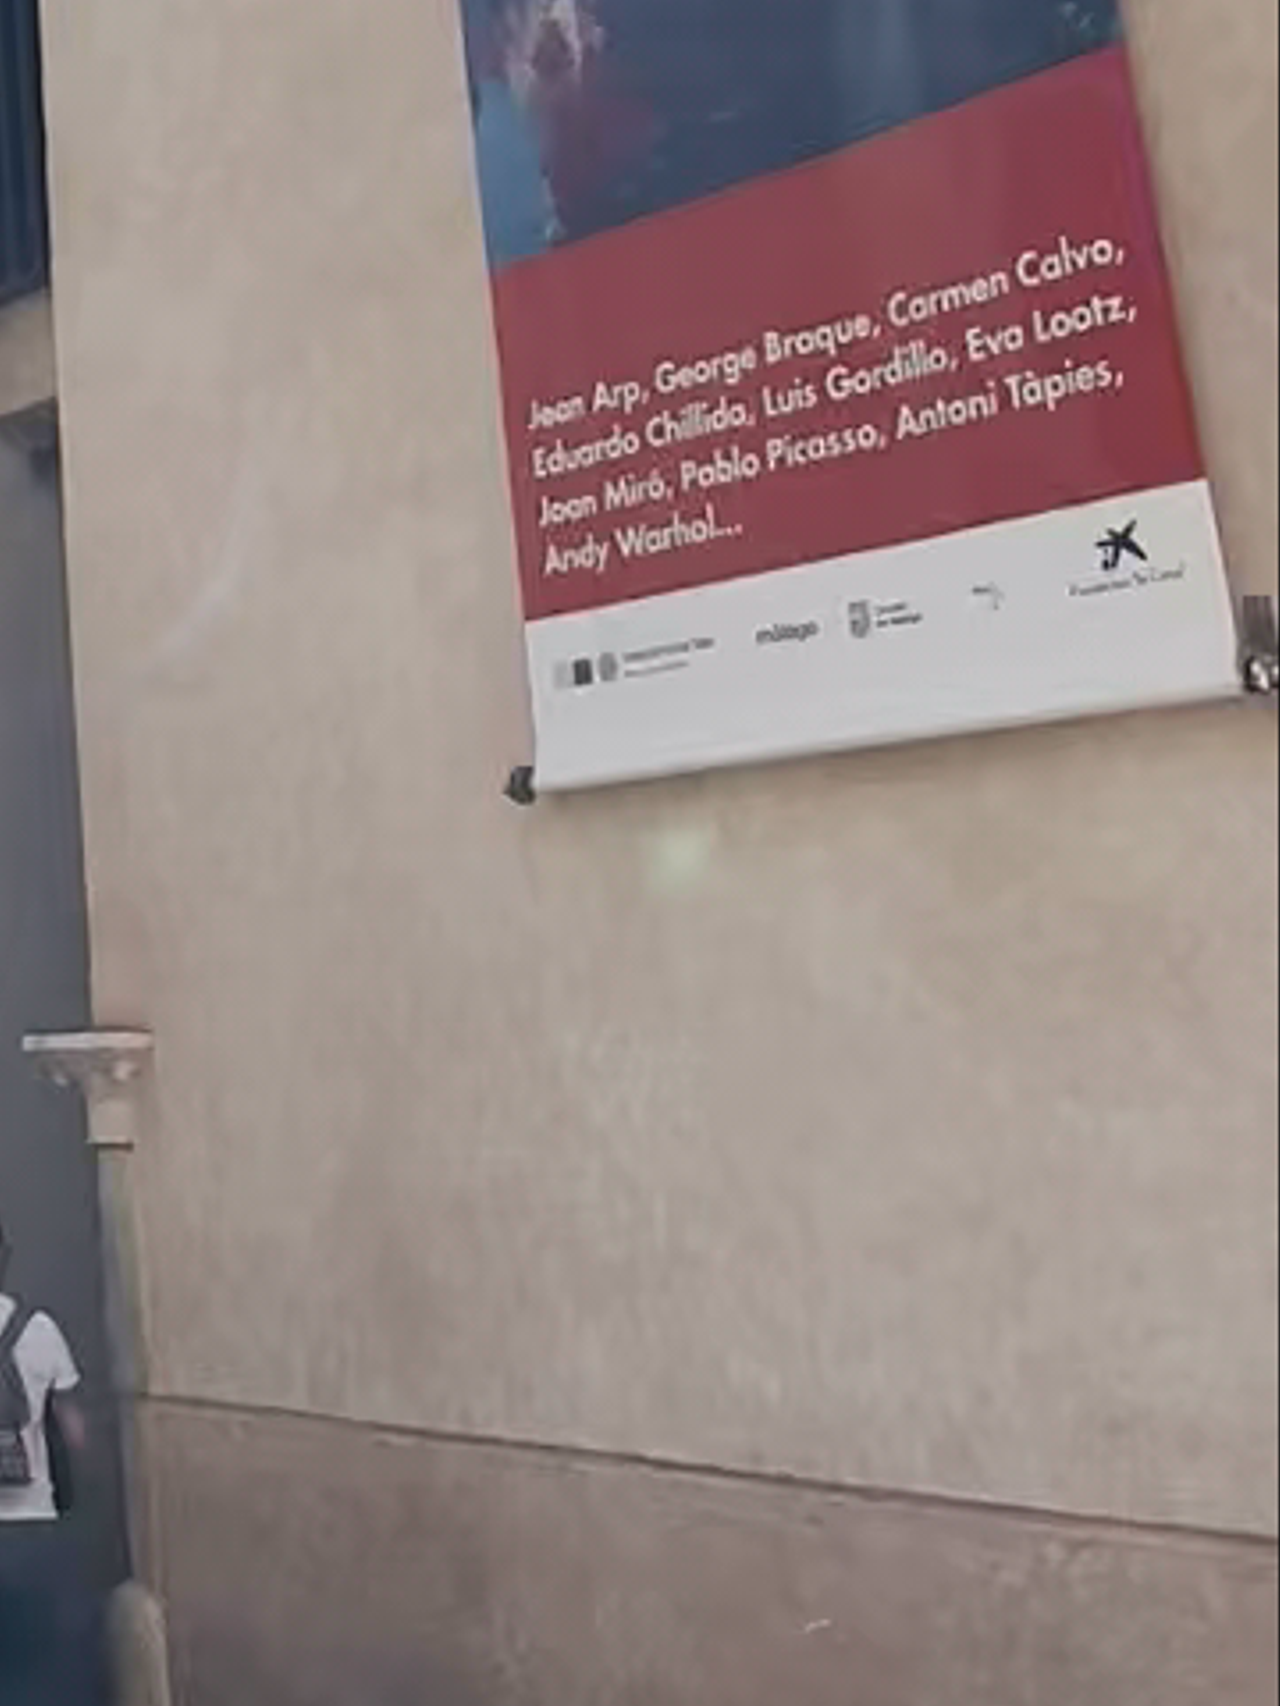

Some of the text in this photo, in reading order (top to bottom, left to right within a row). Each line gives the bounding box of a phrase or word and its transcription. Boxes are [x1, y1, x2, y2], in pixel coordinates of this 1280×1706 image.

[528, 396, 585, 430] Jean
[592, 381, 649, 414] Arp,
[763, 314, 882, 363] Braque,
[888, 271, 1010, 327] Carmen
[1015, 235, 1124, 287] Calvo,
[532, 423, 640, 479] Eduardo
[762, 378, 818, 417] Luis
[825, 338, 959, 400] Gordillo,
[965, 325, 1025, 362] Eva
[539, 359, 1124, 527] Joan Miró, Pablo Picasso, Antoni Tàpies,
[544, 533, 610, 576] Andy
